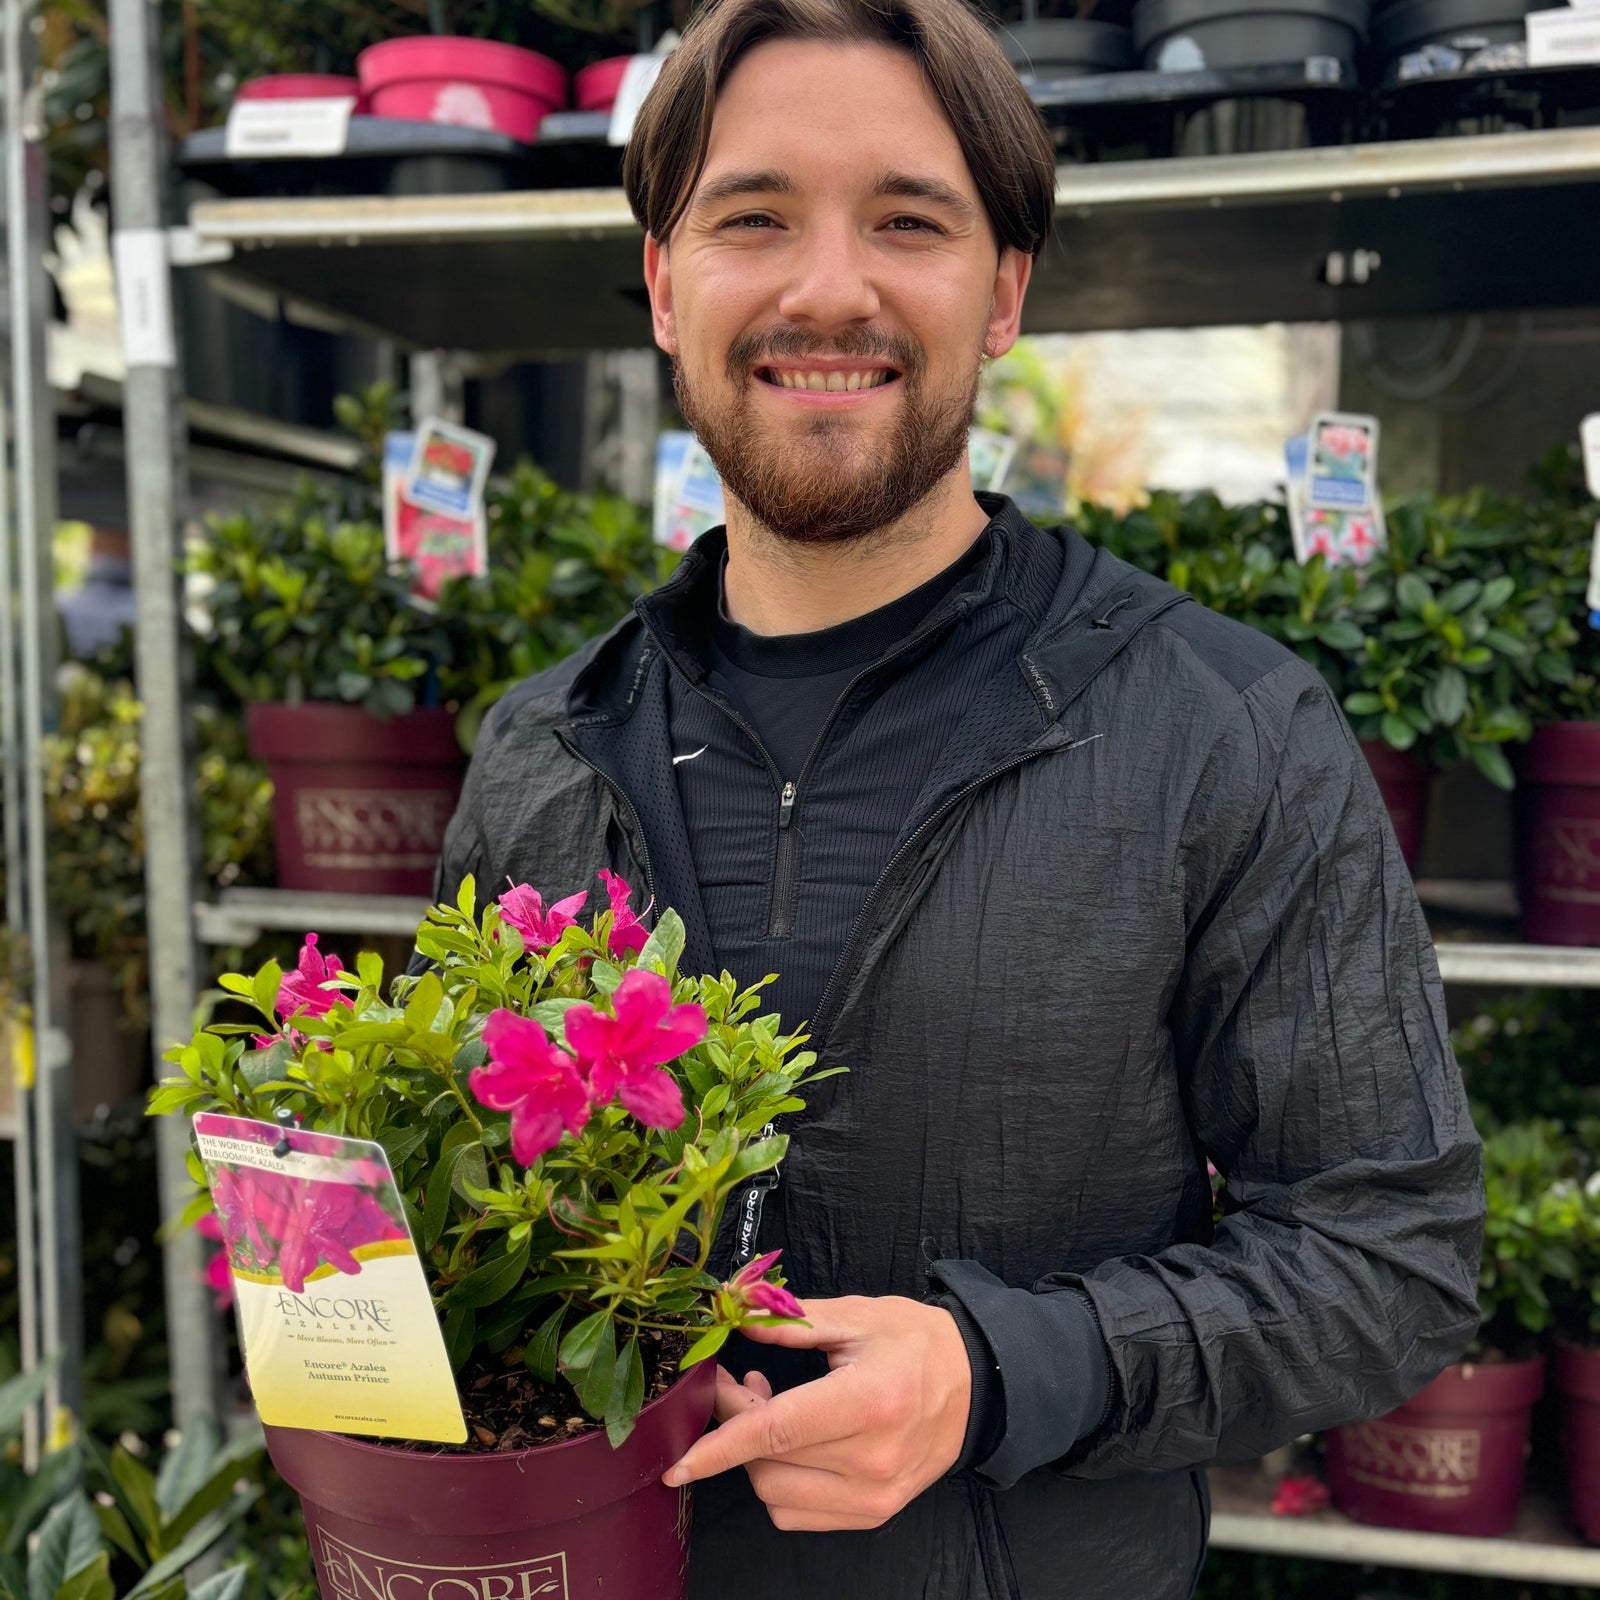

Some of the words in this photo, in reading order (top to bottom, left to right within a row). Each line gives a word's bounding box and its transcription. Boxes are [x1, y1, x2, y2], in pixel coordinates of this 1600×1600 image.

[1028, 665, 1046, 687] NIKE
[1040, 686, 1054, 710] PRO
[201, 1137, 217, 1148] THE
[219, 1140, 254, 1154] WORLD'S
[204, 1148, 257, 1165] REBLOOMING
[258, 1160, 286, 1172] AZALEA
[746, 1189, 759, 1222] PRO
[741, 1221, 753, 1257] NIKE
[274, 1292, 393, 1332] ENCORE
[297, 1334, 315, 1342] More
[367, 1338, 388, 1347] Often
[308, 1371, 352, 1382] Autumn
[353, 1373, 390, 1384] Prince
[350, 1363, 386, 1372] Azalea
